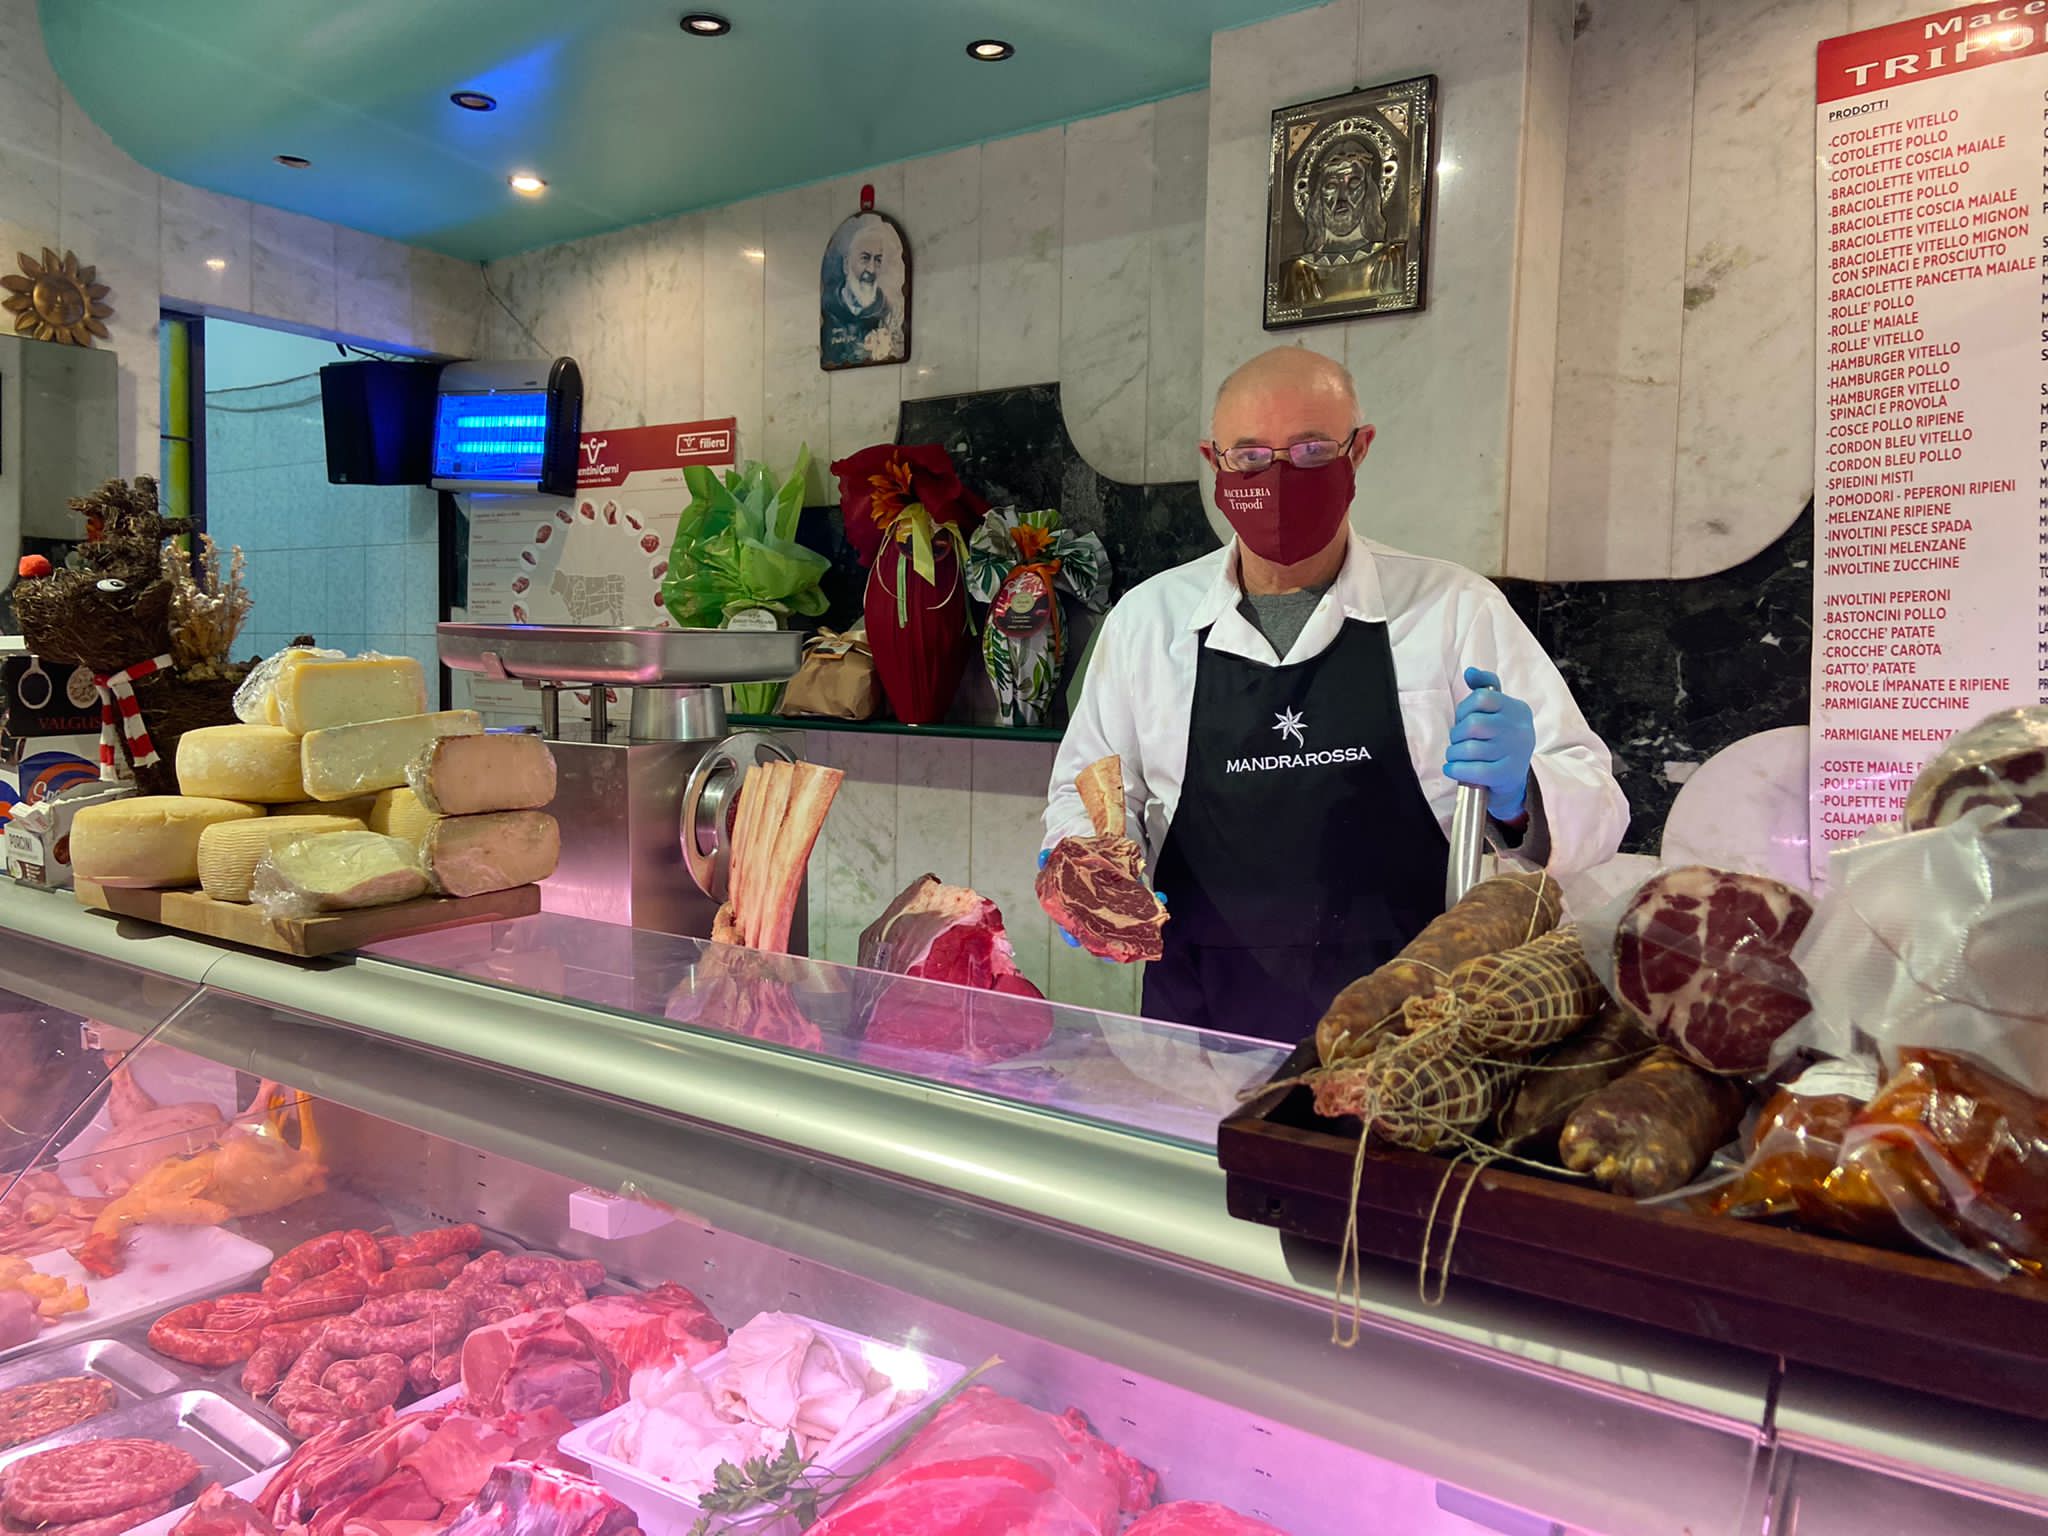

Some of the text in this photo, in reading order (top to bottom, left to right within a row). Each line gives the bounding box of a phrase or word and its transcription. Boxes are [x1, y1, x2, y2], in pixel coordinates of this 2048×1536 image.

[1845, 22, 2048, 86] TRIPO
[1829, 100, 1888, 121] PRODOTTI
[1828, 110, 1958, 148] -COTOLETTE VITELLO
[1827, 130, 1947, 166] -COTOLETTE POLLO
[1828, 136, 2005, 183] -COTOLETTE COSCIA MAIALE
[1828, 162, 1969, 200] -BRACIOLETTE VITELLO
[1829, 182, 1959, 218] -BRACIOLETTE POLLO
[1829, 189, 2016, 235] -BRACIOLETTE COSCIA MAIALE
[1829, 226, 1912, 252] -BRACIOLETTE
[1917, 216, 1969, 236] VITELLO
[1973, 205, 2029, 226] MIGNON
[1829, 244, 1912, 270] -BRACIOLETTE
[1916, 234, 1969, 254] VITELLO
[1973, 224, 2028, 245] MIGNON
[1832, 244, 2007, 285] CON SPINACI E PROSCIUTTO
[1828, 277, 1913, 301] -BRACIOLETTE
[1916, 266, 1983, 287] PANCETTA
[1987, 257, 2036, 276] MAIALE
[1874, 295, 1914, 313] POLLO
[1874, 312, 1918, 330] MAIALE
[1874, 330, 1924, 348] VITELLO
[1827, 342, 1960, 373] -HAMBURGER VITELLO
[1827, 362, 1950, 390] -HAMBURGER POLLO
[1827, 379, 1960, 407] -HAMBURGER VITELLO
[1830, 396, 1947, 421] SPINACI E PROVOLA
[1826, 411, 1964, 438] -COSCE POLLO RIPIENE
[1826, 429, 1973, 456] -CORDON BLEU VITELLO
[577, 463, 619, 476] entiniCarni
[1826, 448, 1962, 473] -CORDON BLEU POLLO
[1826, 471, 1913, 490] -SPIEDINI MISTI
[1224, 488, 1271, 498] MACELLERIA
[1826, 490, 1893, 508] -POMODORI
[1905, 484, 1965, 501] PEPERONI
[1970, 480, 2015, 495] RIPIENI
[1229, 498, 1263, 512] Tripodi
[1825, 503, 1951, 525] -MELENZANE RIPIENE
[1825, 520, 1972, 542] -INVOLTINI PESCE SPADA
[1825, 538, 1966, 559] -INVOLTINI MELENZANE
[1824, 556, 1959, 576] -INVOLTINE ZUCCHINE
[1824, 589, 1950, 607] -INVOLTINI PEPERONI
[1823, 607, 1946, 624] -BASTONCINI POLLO
[1892, 626, 1935, 639] PATATE
[1891, 643, 1942, 657] CAROTA
[1873, 662, 1916, 675] PATATE
[1822, 679, 2010, 693] -PROVOLE IMPANATE E RIPIENE
[1820, 697, 1969, 710] -PARMIGIANE ZUCCHINE
[1821, 729, 1952, 741] -PARMIGIANE MELENZ
[1226, 747, 1371, 773] MANDRAROSSA
[1821, 761, 1864, 774] -COSTE
[1867, 762, 1913, 775] MAIALE
[1819, 795, 1886, 809] -POLPETTE
